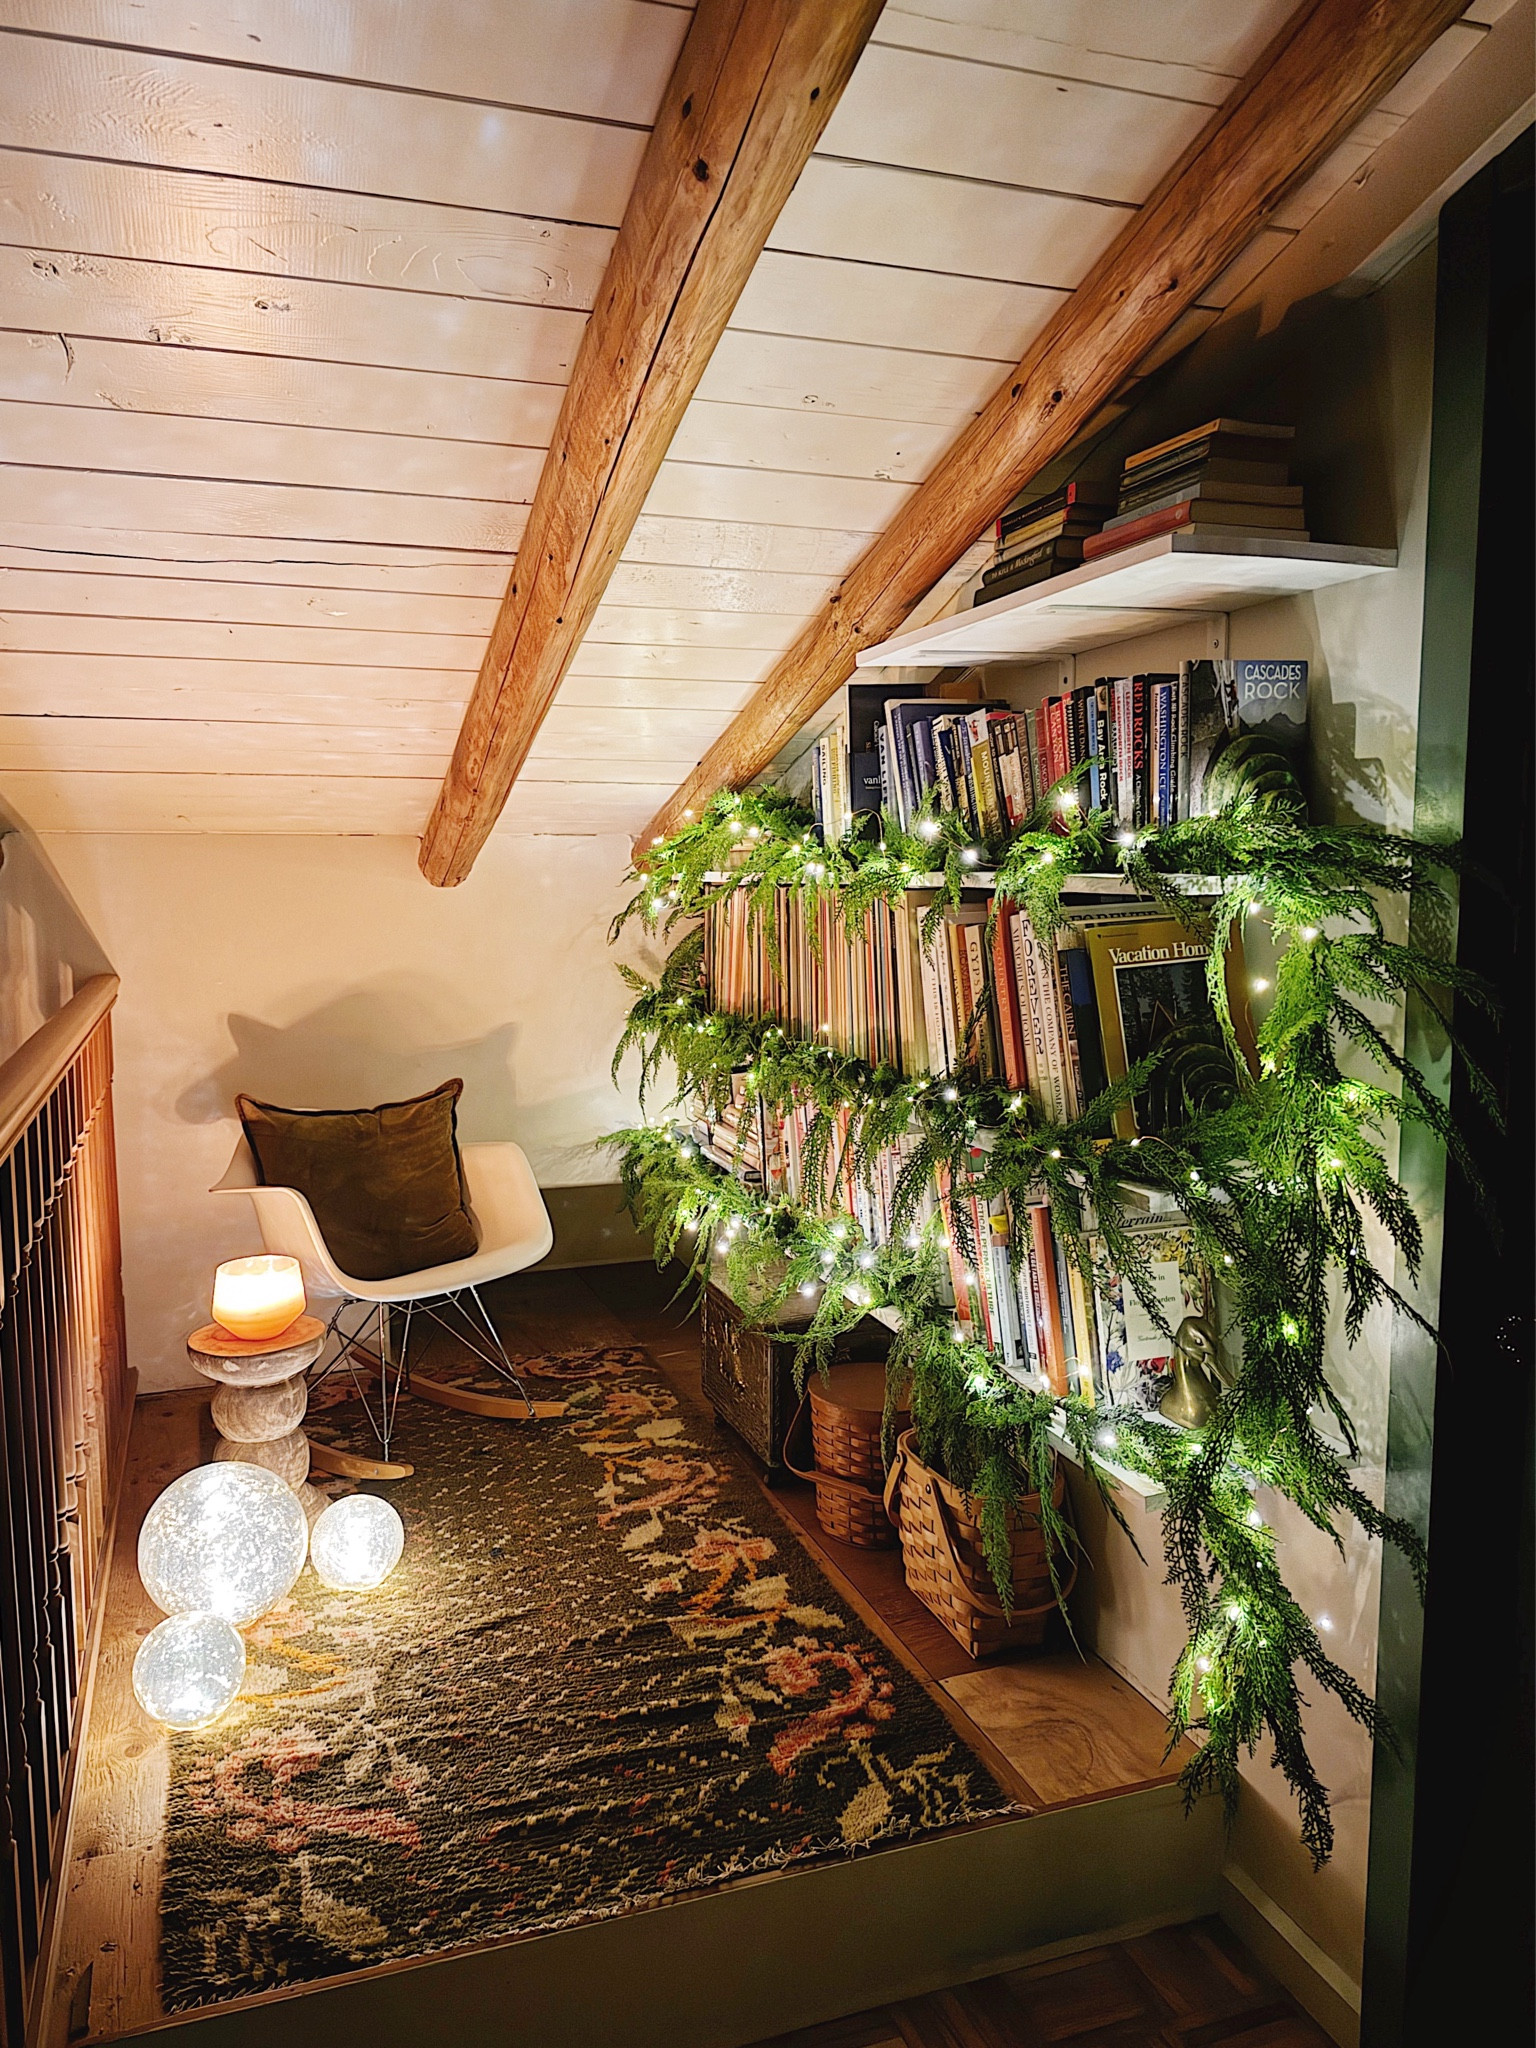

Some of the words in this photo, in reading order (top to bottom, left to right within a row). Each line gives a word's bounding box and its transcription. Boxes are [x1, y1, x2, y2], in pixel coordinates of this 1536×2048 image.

[1244, 664, 1301, 680] CASCADES
[1244, 682, 1300, 700] ROCK
[1134, 682, 1143, 712] RED
[1051, 712, 1060, 762] CANYON
[1134, 719, 1144, 769] ROCKS
[962, 736, 970, 766] Scrambles
[968, 773, 977, 815] WASHINGTON
[980, 751, 1001, 839] MOUNTAINEERIN
[1022, 756, 1031, 792] CASCADE
[1100, 773, 1108, 800] Rock
[970, 942, 982, 998] GYPSY
[1109, 945, 1170, 964] Vacation
[1172, 942, 1208, 958] Hom
[996, 946, 1008, 1012] COUNTRY
[1013, 928, 1025, 991] MEMORIES
[1021, 1012, 1031, 1046] HOME
[1022, 919, 1044, 1055] FOREVER
[1042, 982, 1051, 1004] THE
[1058, 964, 1069, 991] THE
[1064, 992, 1075, 1034] CABIN
[1046, 1010, 1058, 1058] COMPANY
[1054, 1076, 1064, 1115] WOMEN
[1117, 1213, 1163, 1227] terrain
[977, 1196, 987, 1234] ACTICAL
[982, 1238, 994, 1316] PERMACULTURE
[1031, 1251, 1039, 1292] VEGETABLES
[1024, 1286, 1032, 1326] NORTHWEST
